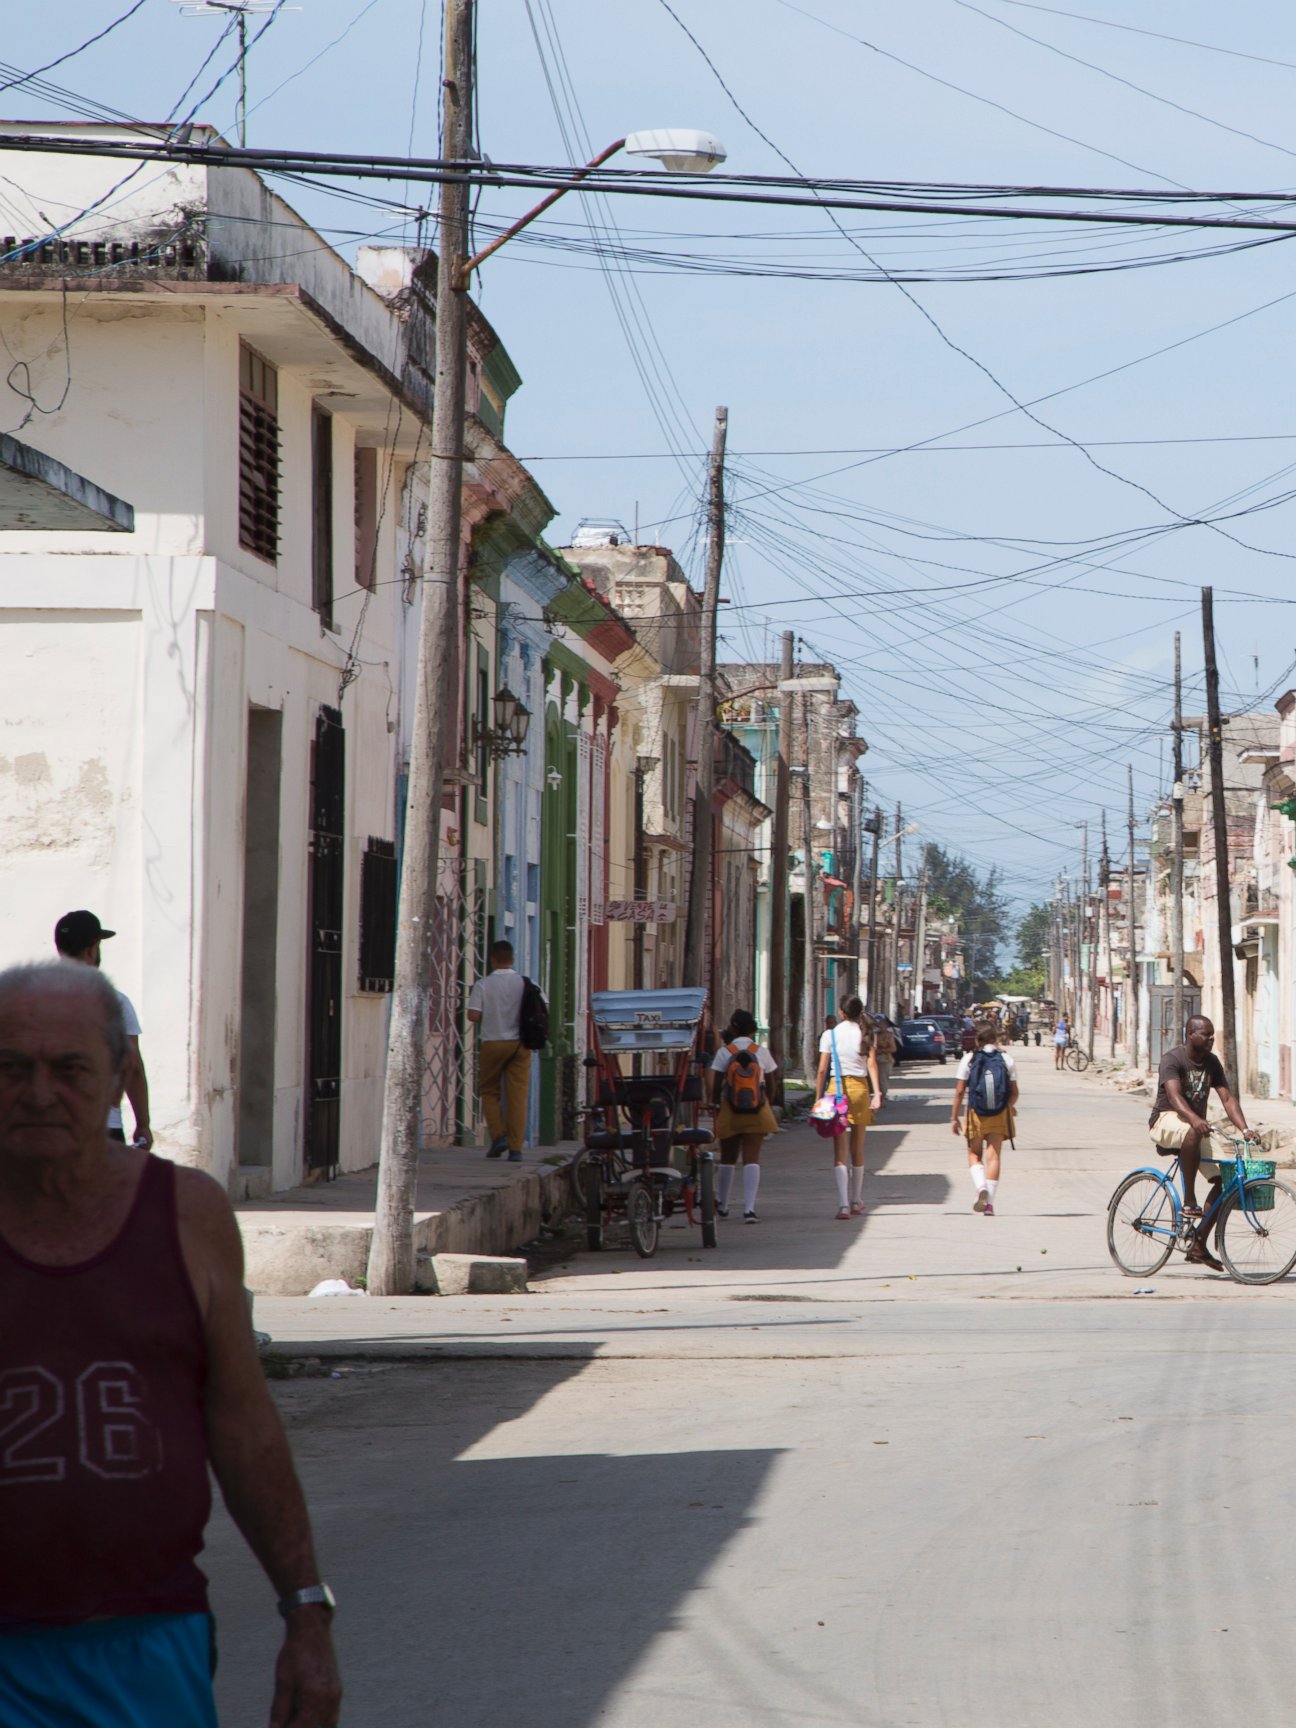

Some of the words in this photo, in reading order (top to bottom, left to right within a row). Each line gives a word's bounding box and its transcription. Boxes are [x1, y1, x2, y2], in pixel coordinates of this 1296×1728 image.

[617, 910, 655, 921] CASA
[635, 1013, 661, 1023] TAXI
[0, 1361, 164, 1483] 26
